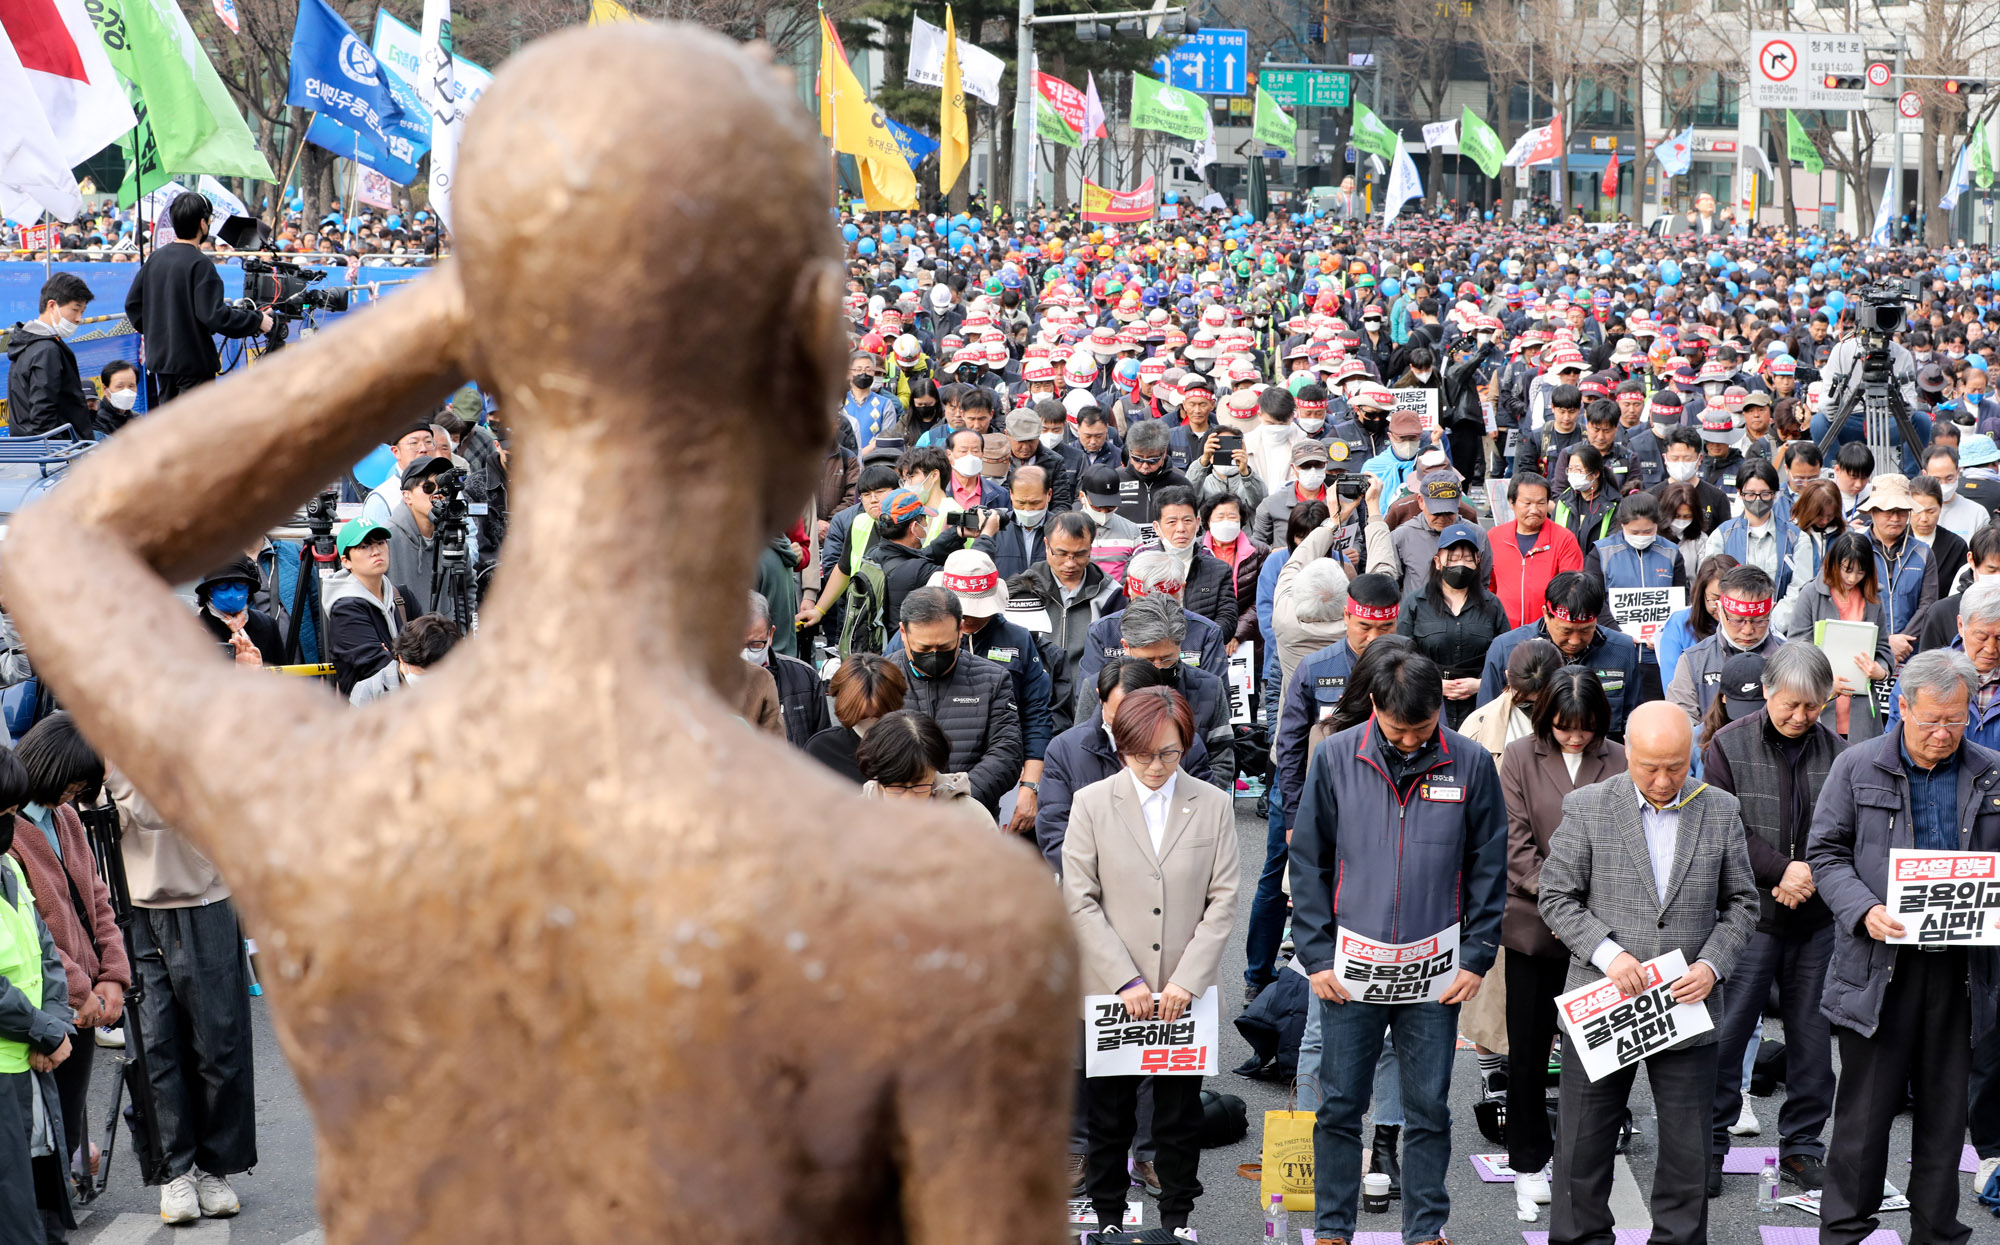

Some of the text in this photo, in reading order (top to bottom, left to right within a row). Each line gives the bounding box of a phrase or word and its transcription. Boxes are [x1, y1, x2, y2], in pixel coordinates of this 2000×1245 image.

[1219, 35, 1243, 46] 청계천
[1811, 41, 1860, 53] 청계천로
[1872, 69, 1885, 80] 30
[970, 577, 988, 590] 투쟁
[1614, 589, 1669, 609] 강제동원
[1724, 597, 1765, 613] 단결 투쟁
[1355, 604, 1397, 617] 단결 투쟁
[1616, 606, 1671, 625] 굴욕해법
[1318, 678, 1344, 686] 단결투쟁
[1898, 857, 1992, 880] 윤석열 정부
[1918, 910, 1985, 943] 심판!
[1345, 939, 1434, 962] 윤석열 정부
[1344, 948, 1454, 983] 굴욕외교
[1363, 979, 1432, 1002] 심판!
[1097, 1021, 1196, 1052] 굴욕해법
[1616, 1012, 1678, 1066] 심판!
[1140, 1046, 1207, 1073] 무효!
[1284, 1138, 1299, 1146] FINEST
[1283, 1162, 1315, 1178] TW
